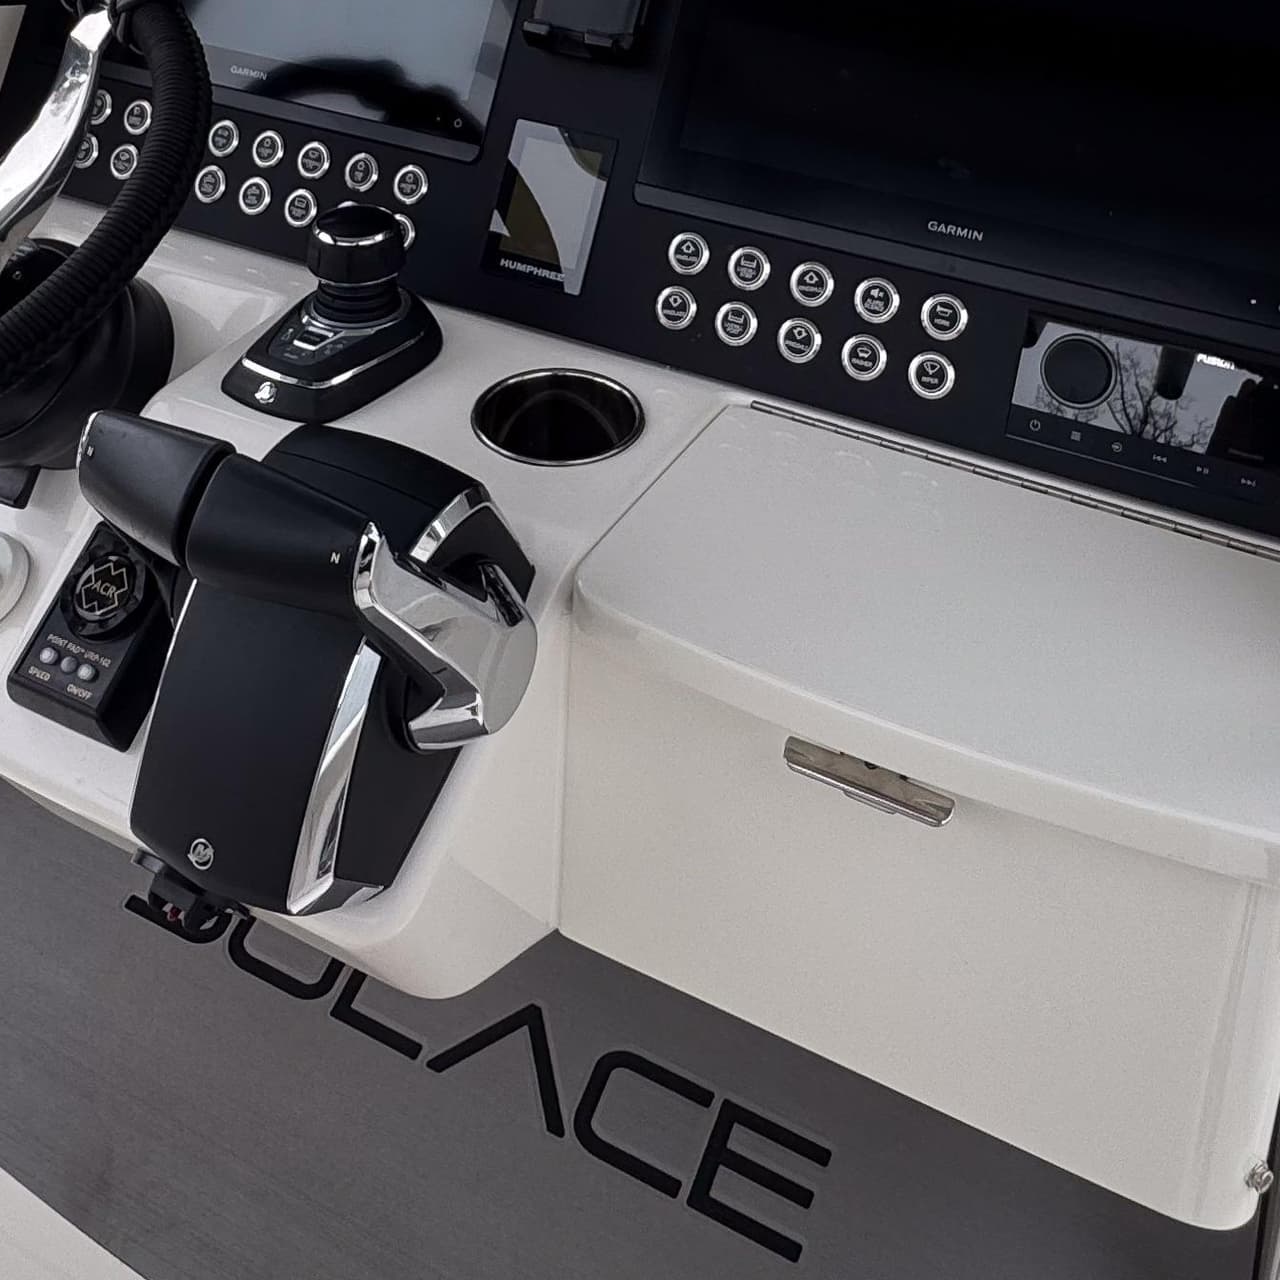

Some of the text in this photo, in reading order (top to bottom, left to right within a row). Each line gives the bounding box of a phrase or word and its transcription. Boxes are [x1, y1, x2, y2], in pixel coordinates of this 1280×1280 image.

[230, 65, 267, 81] GARMIN
[927, 221, 984, 242] GARMIN
[329, 551, 341, 564] N
[91, 579, 117, 599] ACR
[28, 666, 51, 682] SPEED
